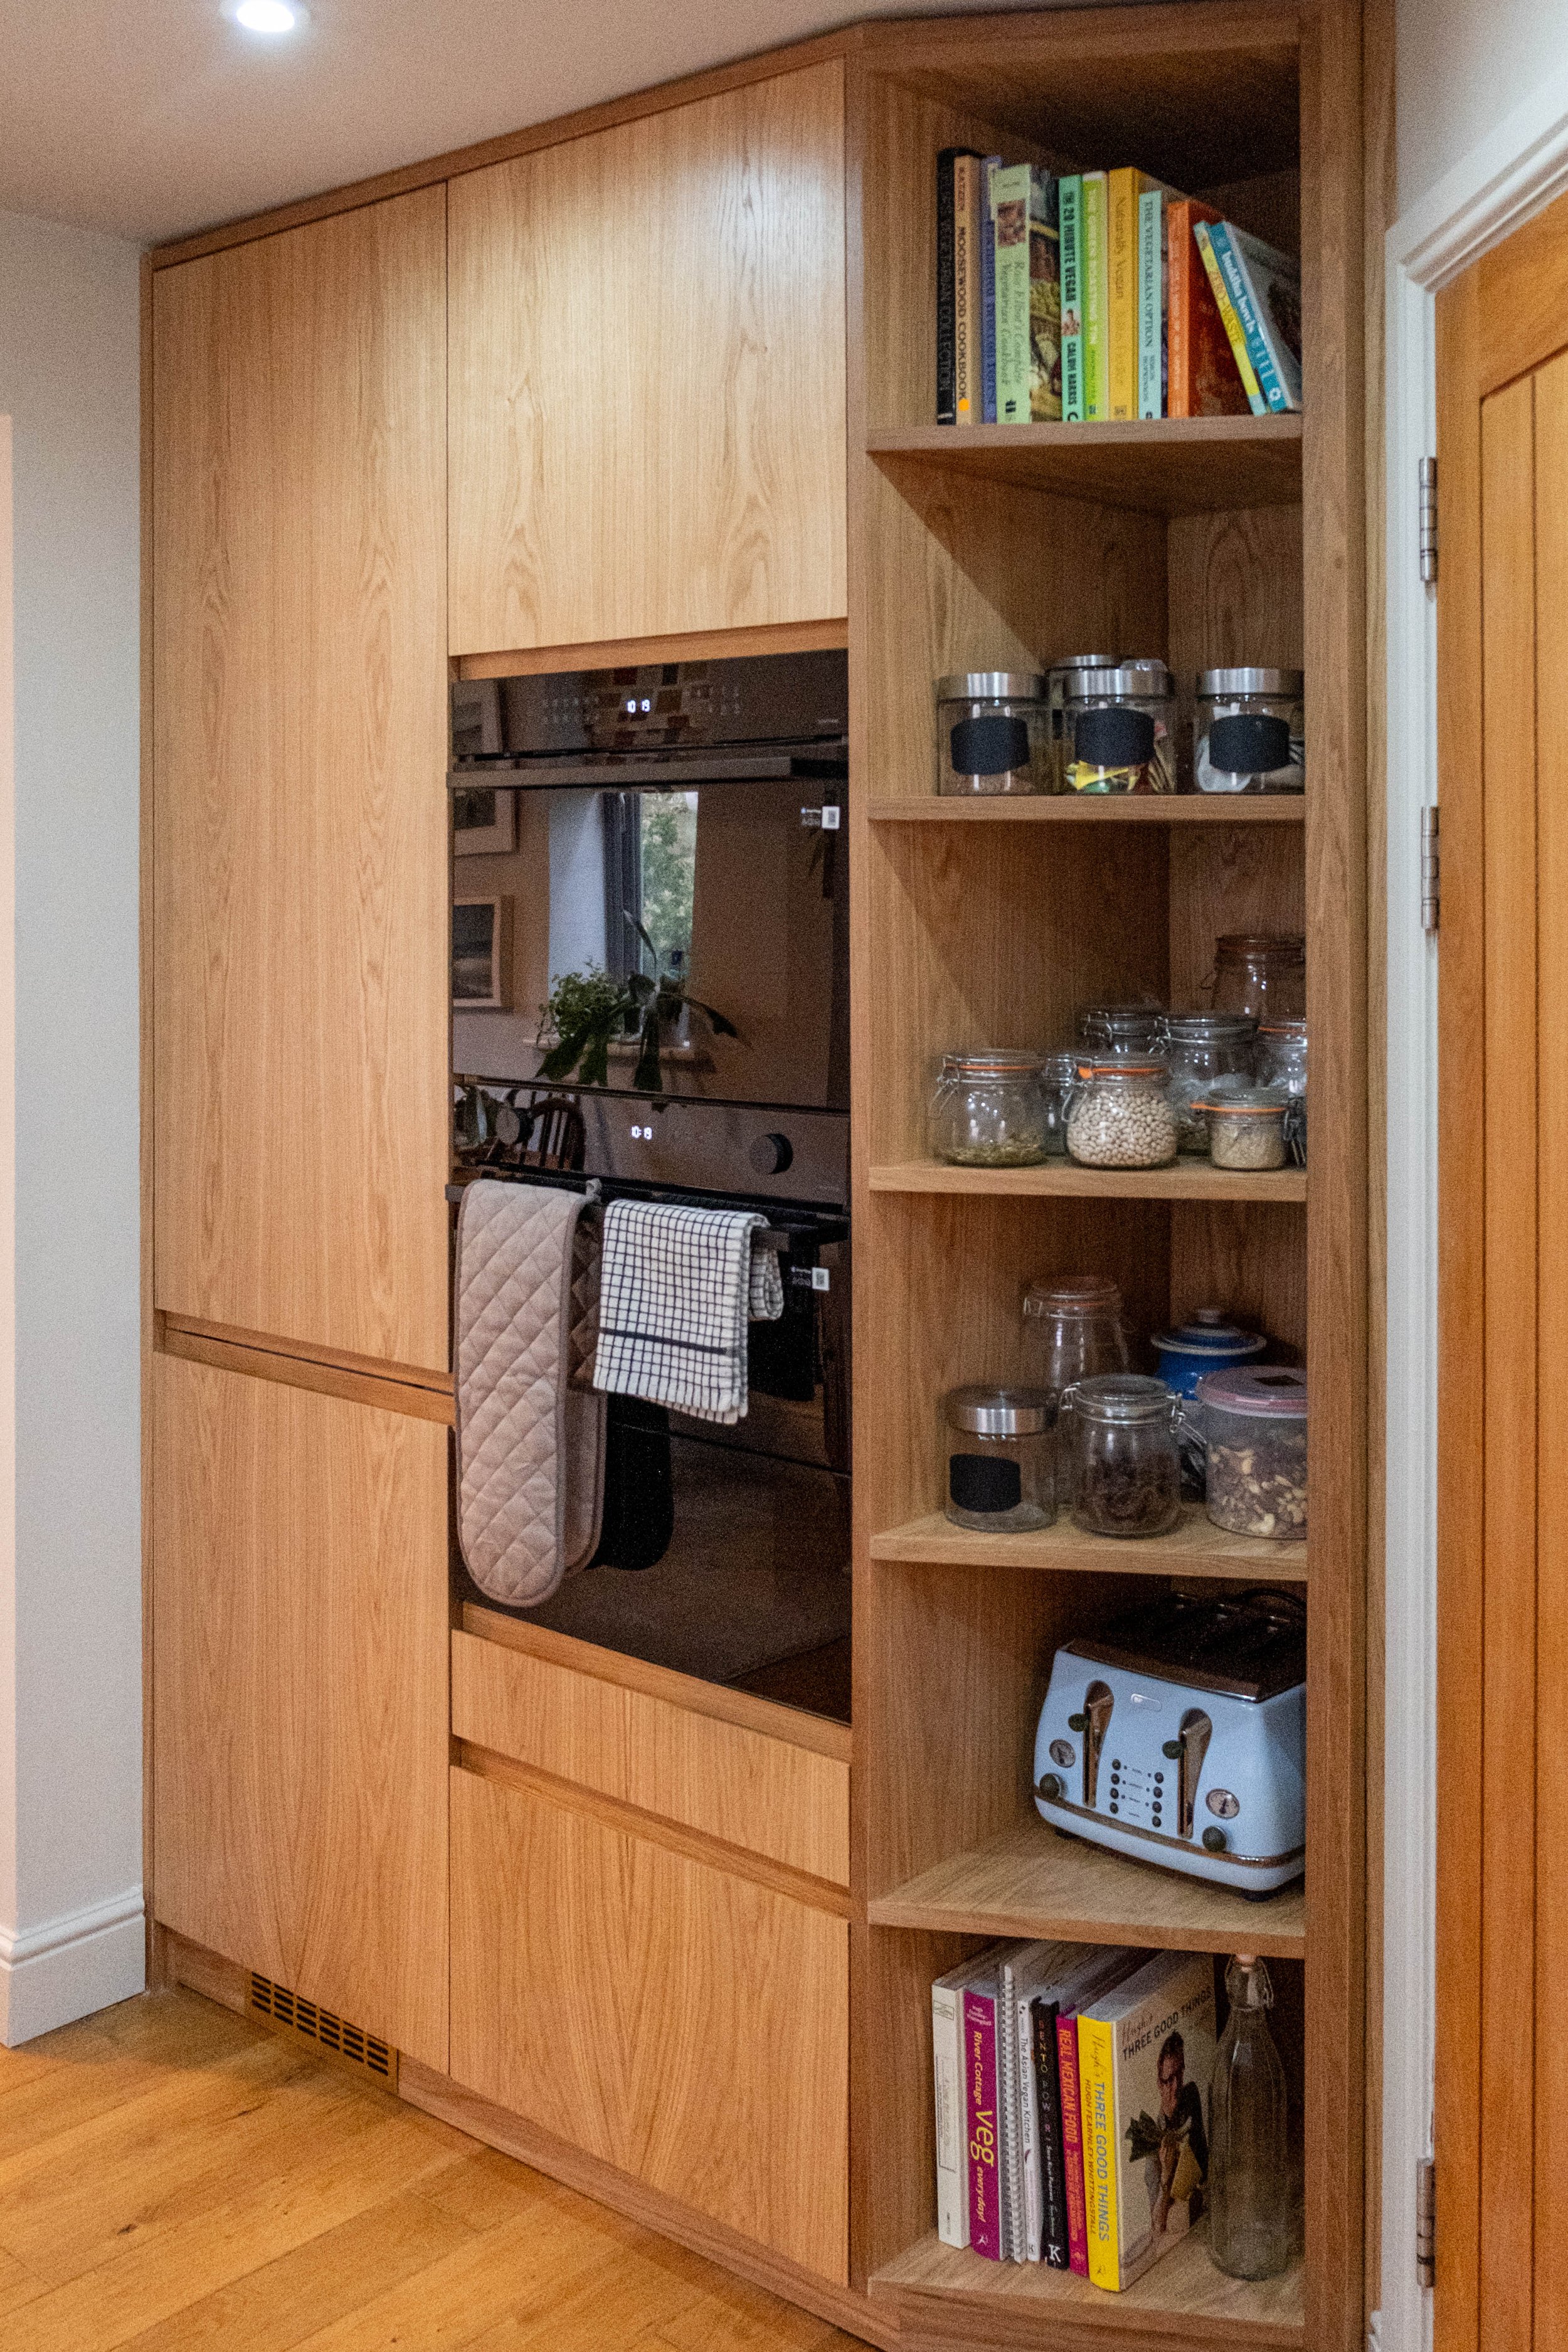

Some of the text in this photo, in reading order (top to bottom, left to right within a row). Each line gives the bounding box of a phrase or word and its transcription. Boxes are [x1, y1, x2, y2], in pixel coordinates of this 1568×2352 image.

[1064, 224, 1076, 265] MINUTE
[1088, 215, 1097, 257] GREEN
[957, 226, 967, 318] MOOSEWOOD
[1065, 267, 1076, 302] VEGAN
[1089, 260, 1098, 320] ROASTING
[1115, 260, 1126, 299] Vegan
[1145, 201, 1154, 347] THE VEGETARIAN OPTION
[1222, 251, 1243, 297] buddha
[938, 305, 953, 390] COLLECTION
[1089, 325, 1098, 345] TIN
[958, 322, 967, 400] COOKBOOK
[1067, 342, 1077, 372] CALUM
[1067, 374, 1077, 405] HARRIS
[1058, 2029, 1071, 2059] REAL
[1122, 1986, 1212, 2062] THREE GOOD THINGS
[1122, 2013, 1153, 2045] Hugh's
[973, 2031, 983, 2060] River
[974, 2062, 984, 2105] Cottage
[1020, 2081, 1030, 2107] Vegan
[1061, 2061, 1074, 2111] MEXICAN
[1023, 2109, 1032, 2143] Kitchen
[1064, 2113, 1078, 2143] FOOD
[1090, 2033, 1109, 2241] Hugh's THREE GOOD THINGS
[1049, 2244, 1061, 2263] K
